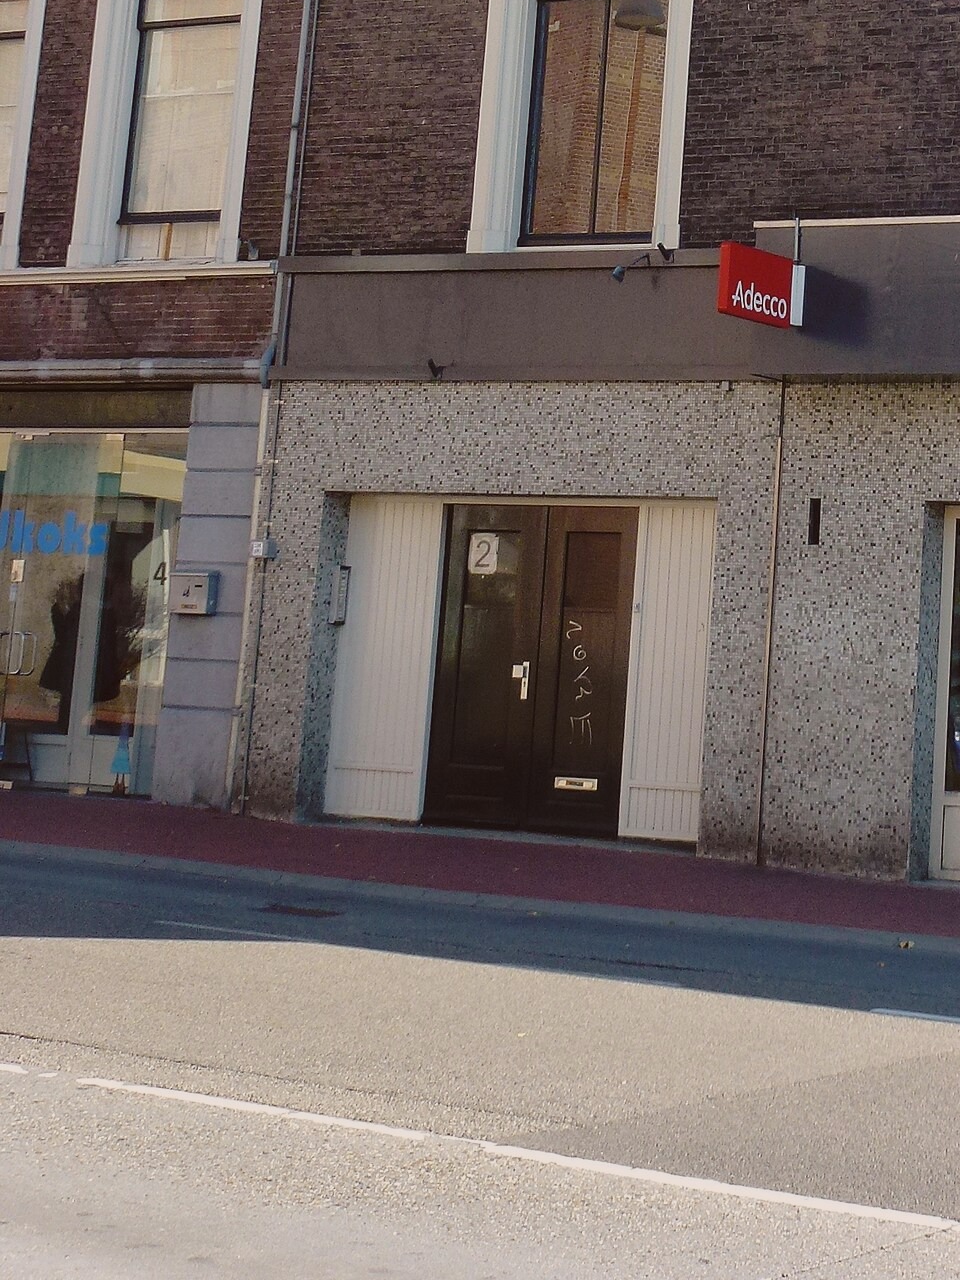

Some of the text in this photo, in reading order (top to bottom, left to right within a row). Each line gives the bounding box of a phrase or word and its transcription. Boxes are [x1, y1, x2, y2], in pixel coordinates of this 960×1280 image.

[731, 280, 787, 319] Adecco
[474, 540, 491, 568] 2
[153, 561, 168, 586] 4
